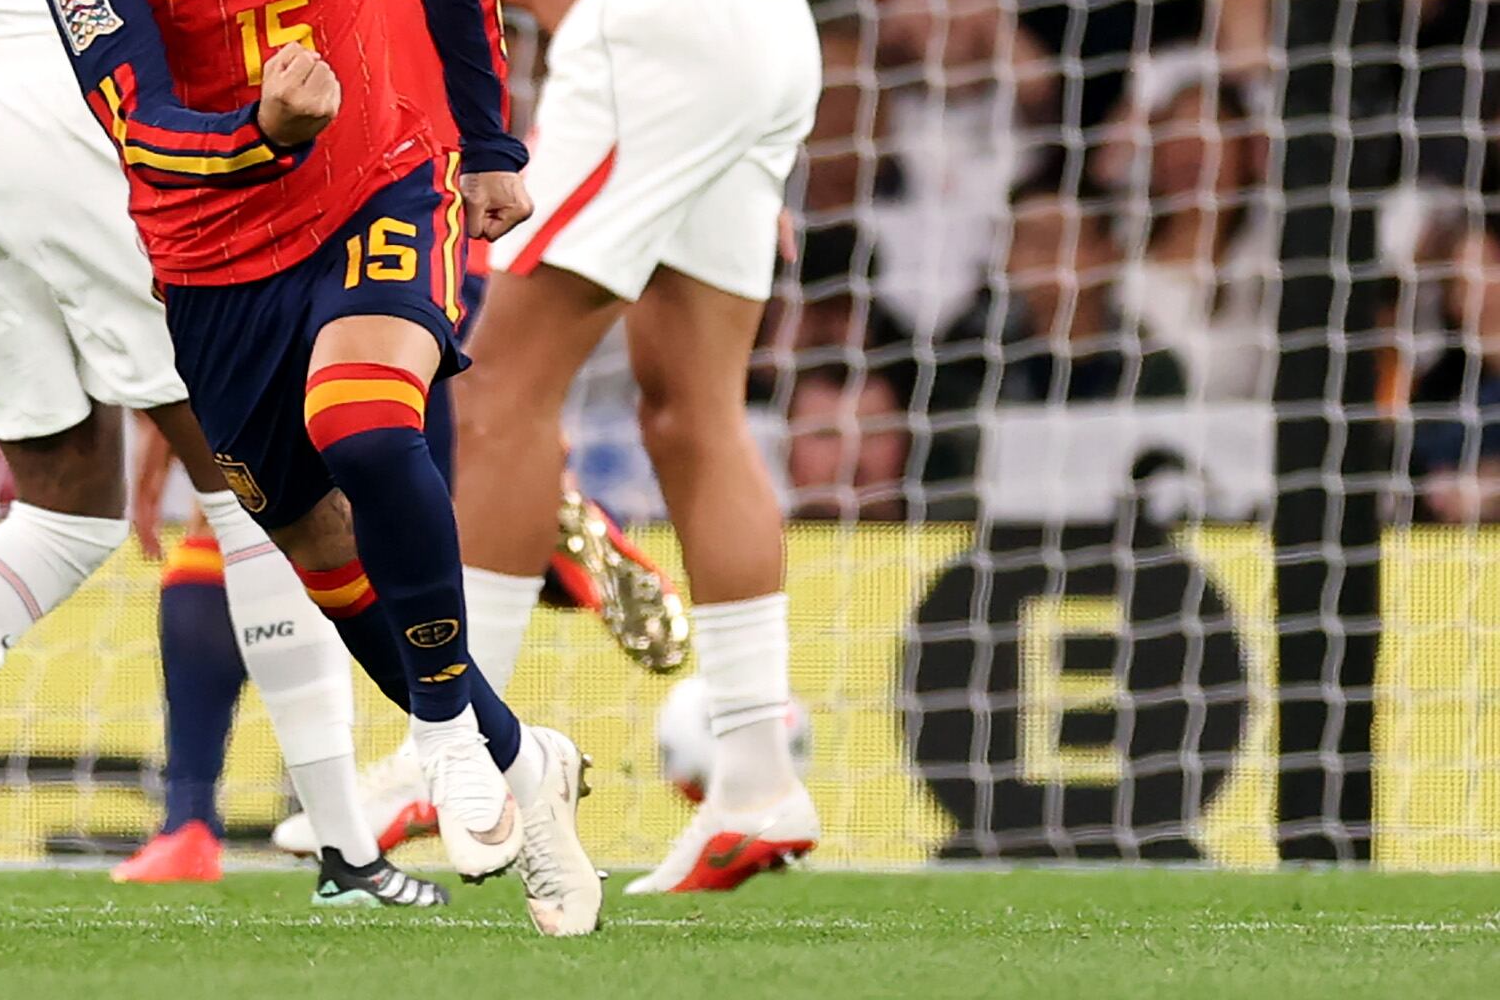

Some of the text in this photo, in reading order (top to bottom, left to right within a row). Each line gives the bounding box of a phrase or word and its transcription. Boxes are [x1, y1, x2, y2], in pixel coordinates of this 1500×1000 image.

[343, 216, 418, 291] 15
[243, 620, 295, 647] ENG
[1017, 596, 1124, 786] E
